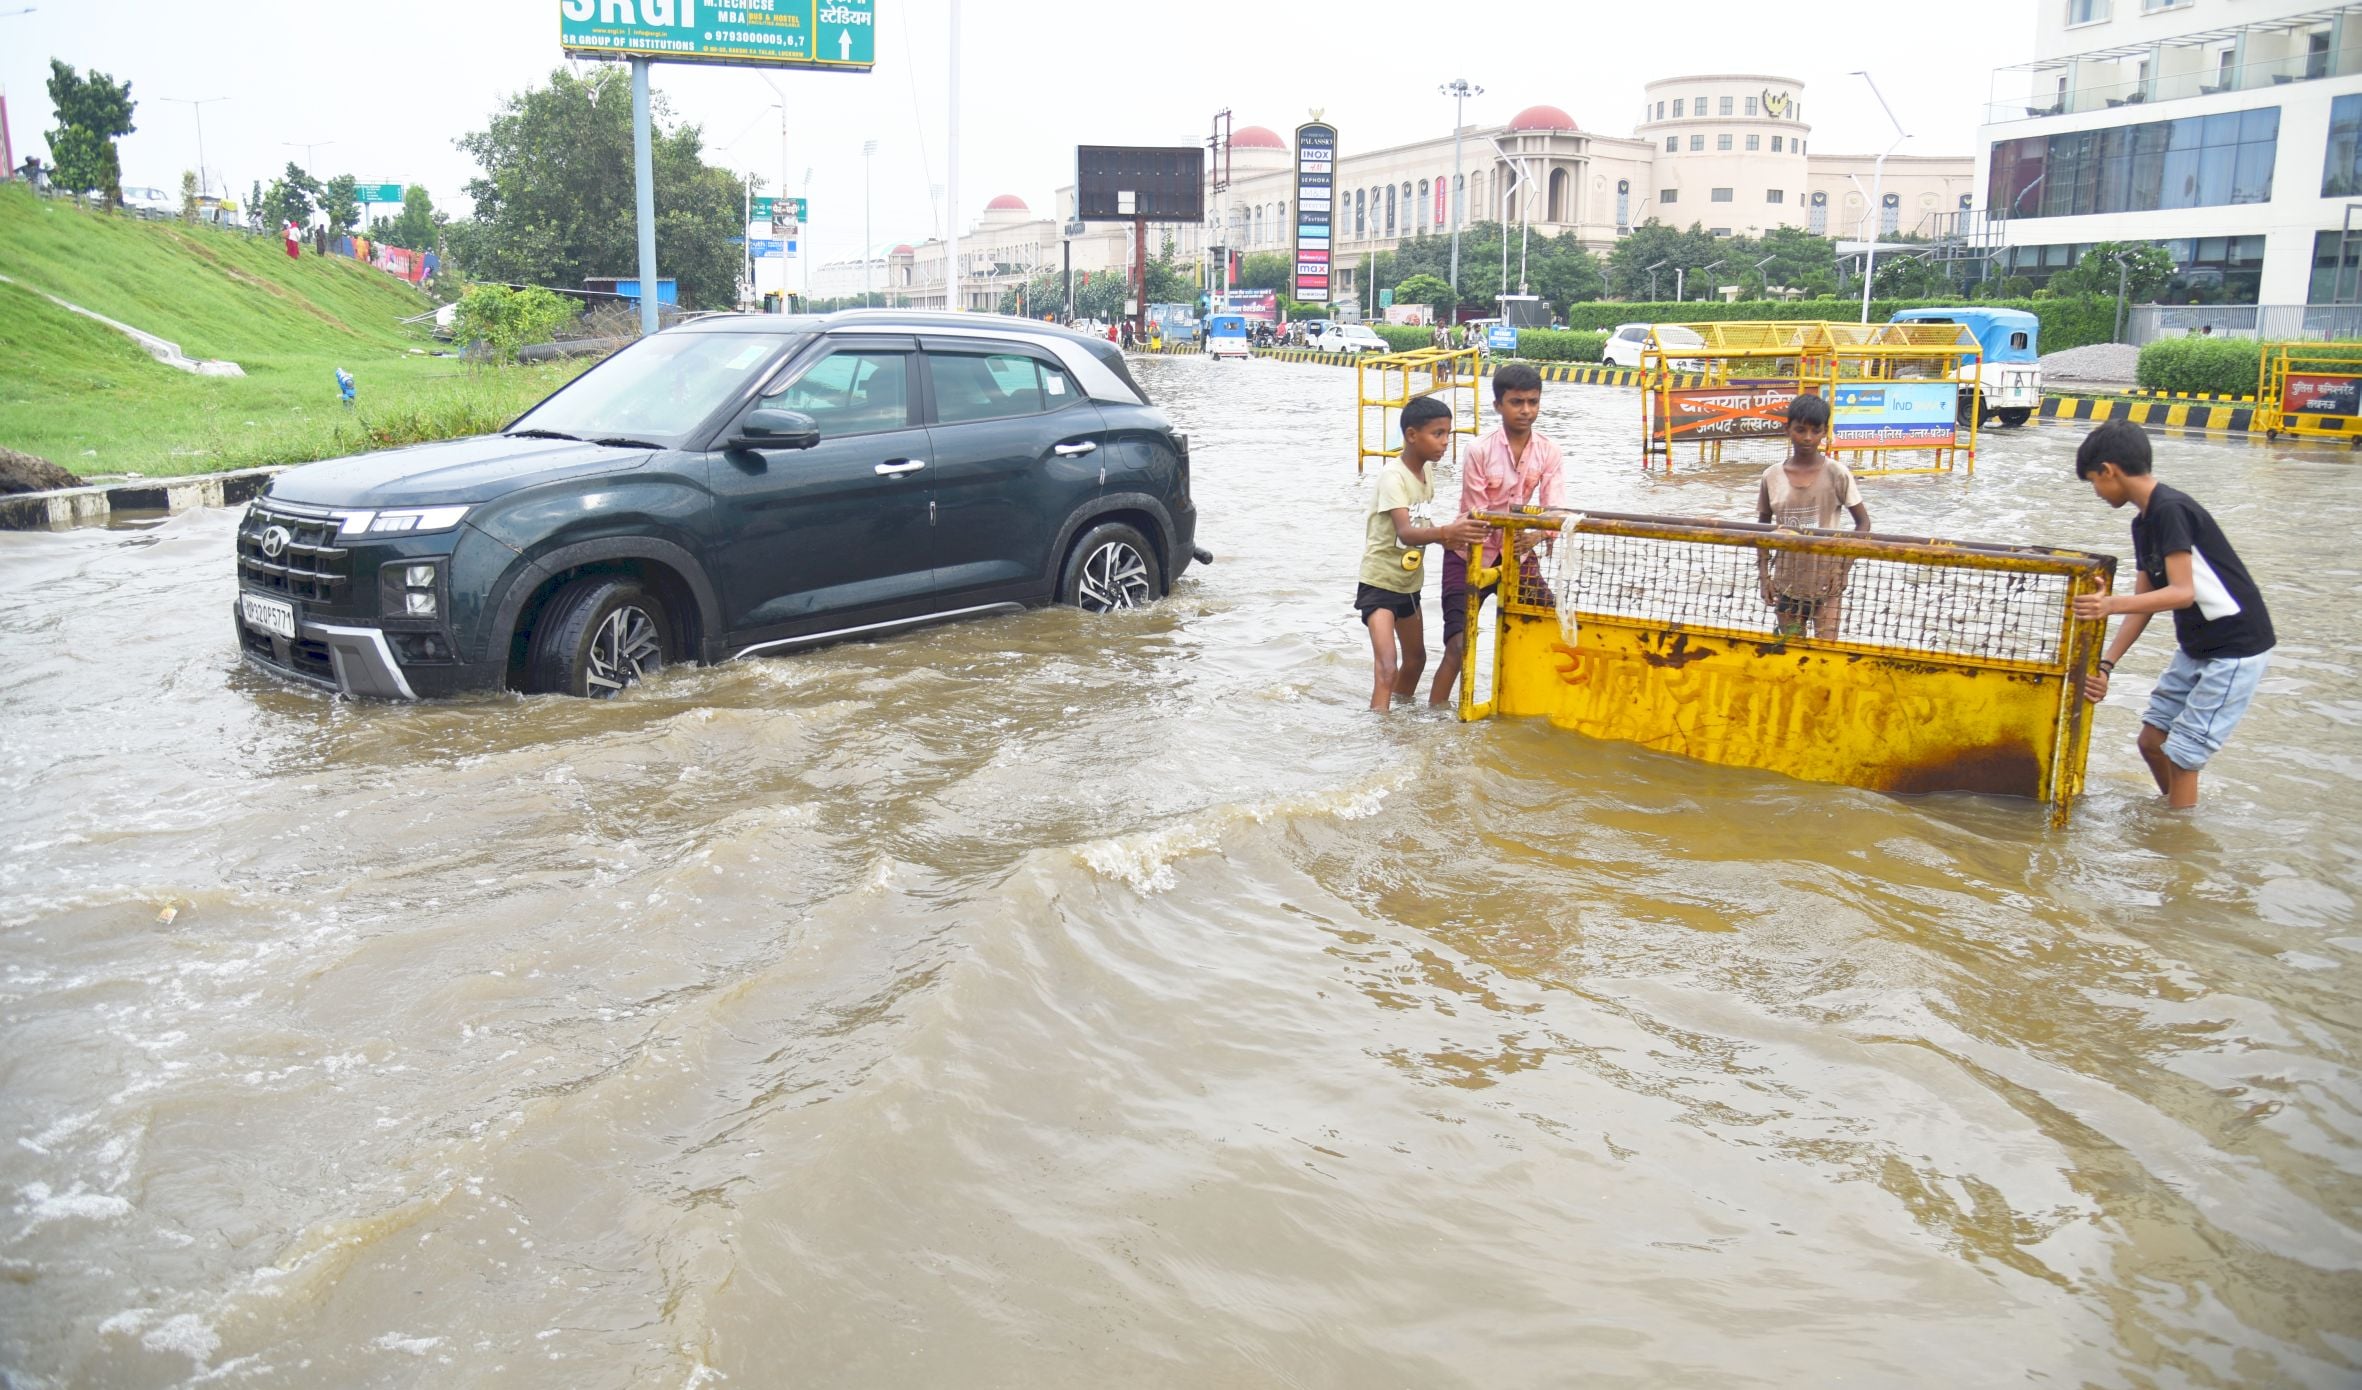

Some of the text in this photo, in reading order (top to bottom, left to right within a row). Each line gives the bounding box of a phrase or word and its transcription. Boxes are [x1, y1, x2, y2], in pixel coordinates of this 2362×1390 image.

[562, 0, 695, 27] SRGI
[718, 11, 745, 24] MBA
[819, 5, 872, 26] स्टेडियम
[578, 35, 611, 46] GROUP
[613, 37, 626, 47] OF
[629, 38, 695, 51] INSTITUTIONS
[1303, 151, 1329, 159] INOX
[1299, 265, 1326, 273] max
[1837, 429, 1875, 441] यातायात
